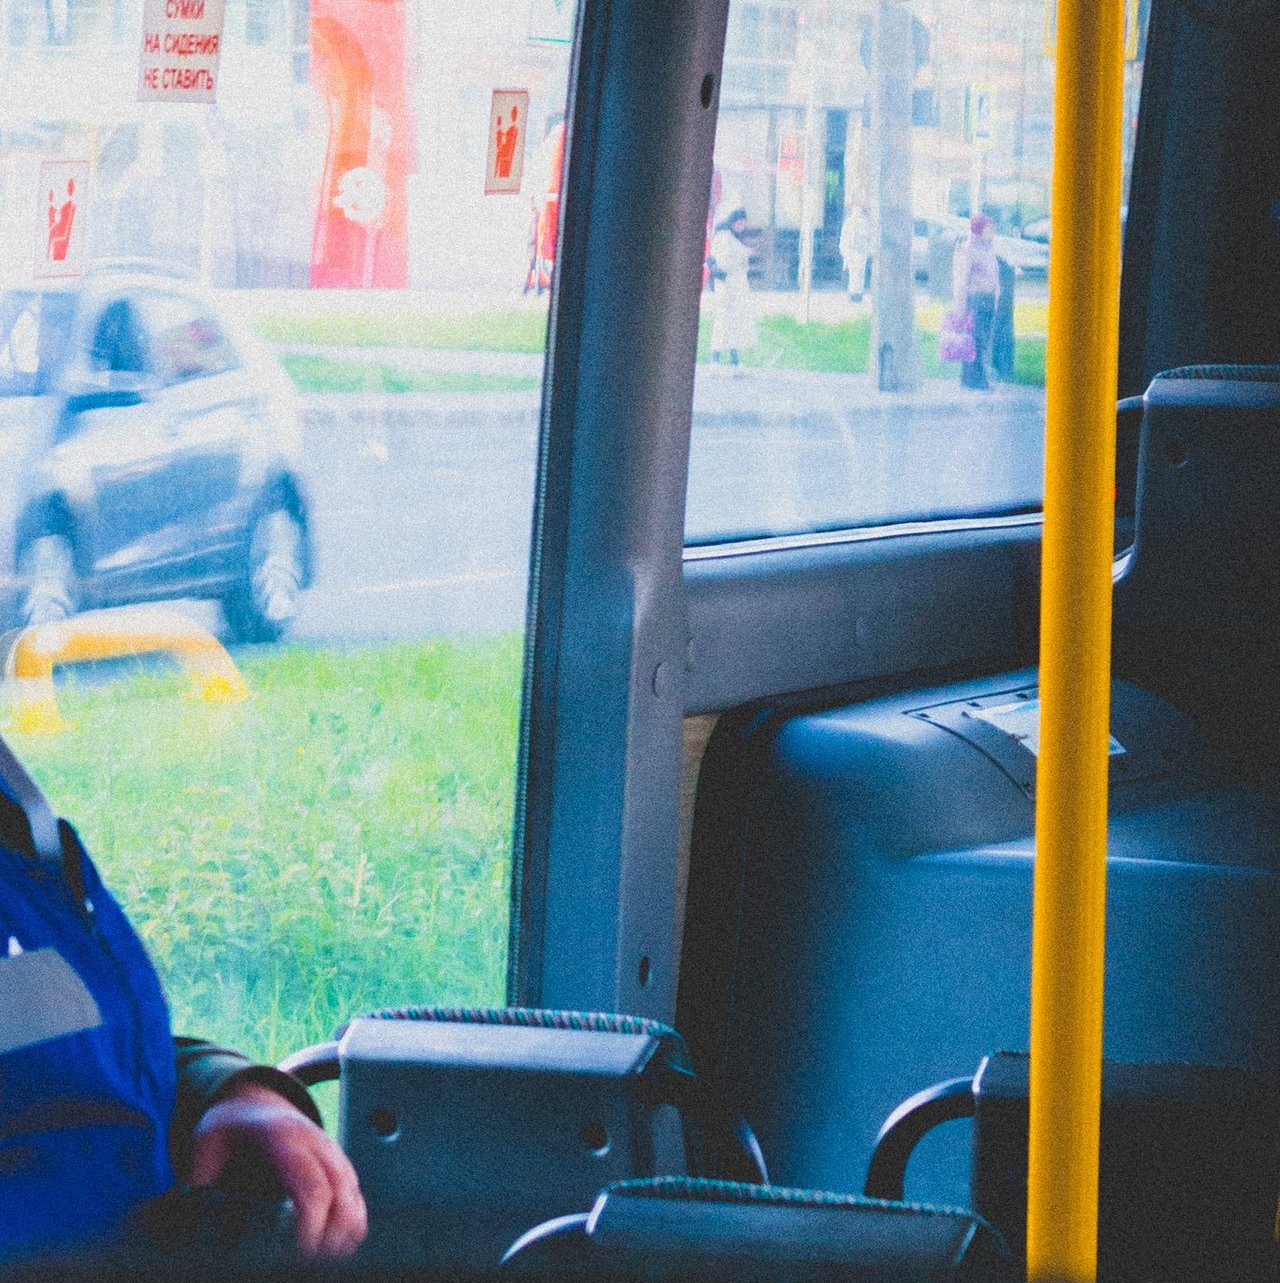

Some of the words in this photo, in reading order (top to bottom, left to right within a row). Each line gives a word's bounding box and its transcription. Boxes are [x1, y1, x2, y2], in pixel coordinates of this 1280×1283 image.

[144, 32, 160, 53] НА
[164, 32, 220, 56] СИДЕНИЯ
[143, 68, 159, 90] НЕ
[162, 68, 214, 91] СТАВИТЬ
